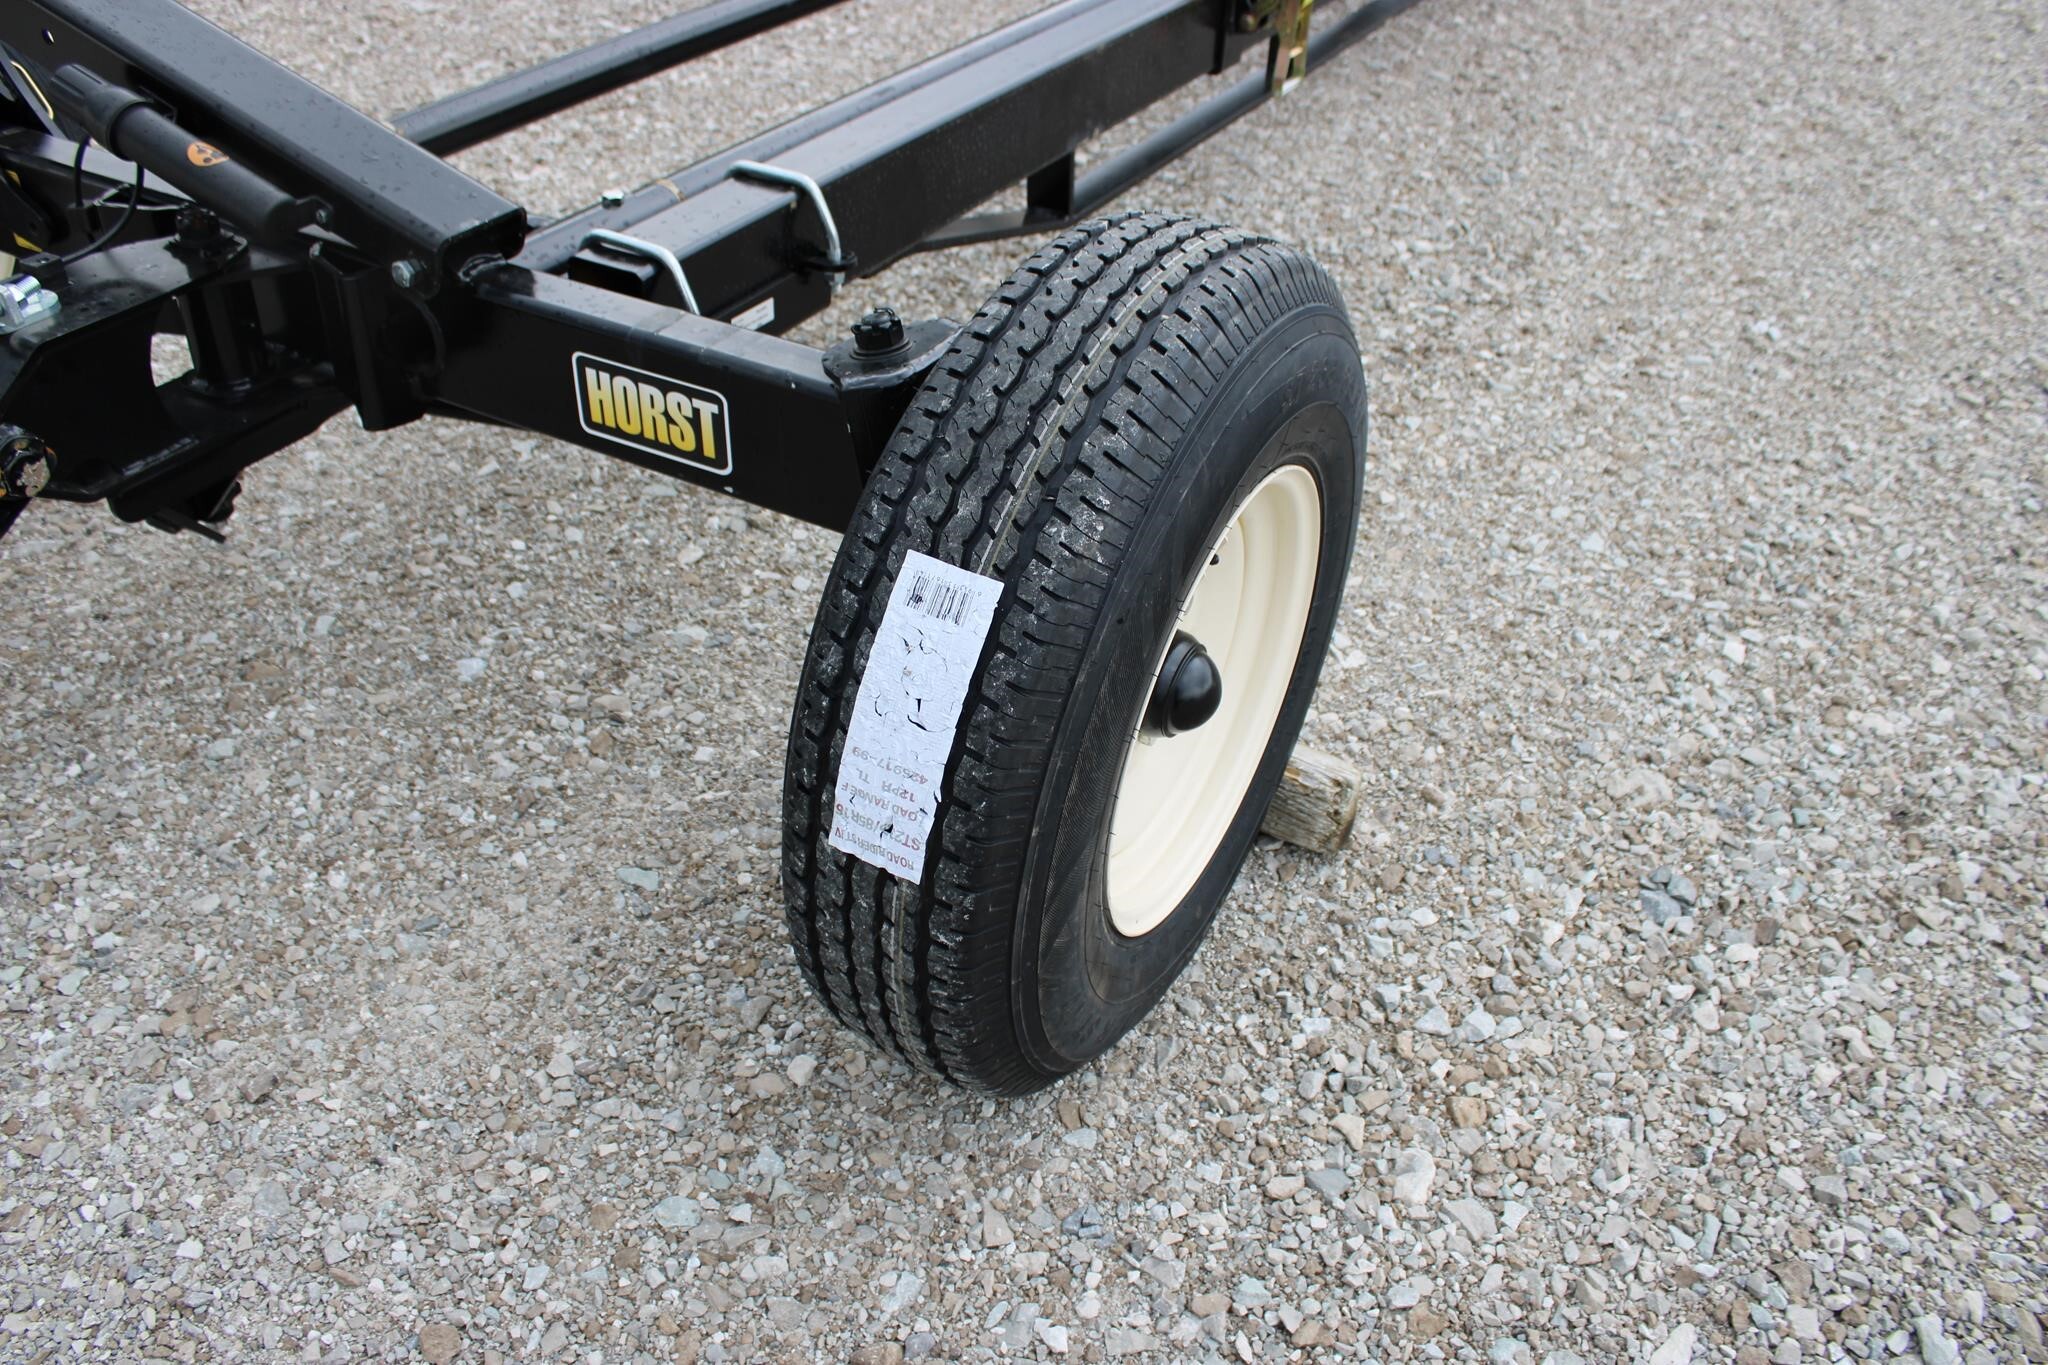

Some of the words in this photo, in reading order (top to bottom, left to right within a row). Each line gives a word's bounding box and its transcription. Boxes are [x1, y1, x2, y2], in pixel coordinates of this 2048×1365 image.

[585, 367, 719, 459] HORST
[855, 767, 870, 784] TL
[848, 784, 889, 810] RANGE
[880, 779, 915, 802] 12PR
[856, 837, 887, 857] RIDER
[884, 851, 915, 870] ROAD
